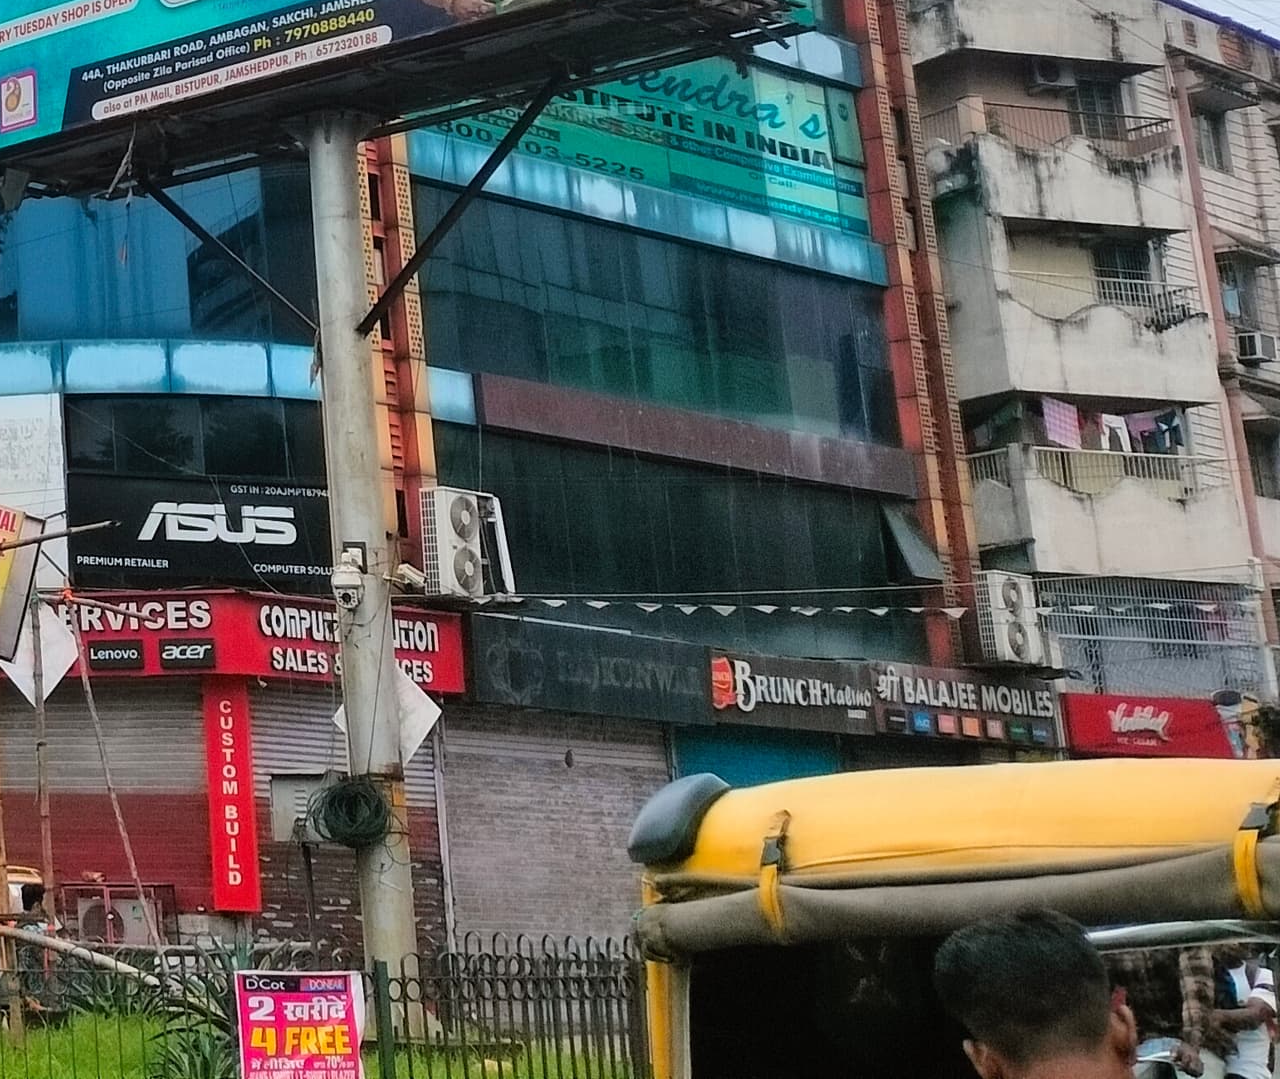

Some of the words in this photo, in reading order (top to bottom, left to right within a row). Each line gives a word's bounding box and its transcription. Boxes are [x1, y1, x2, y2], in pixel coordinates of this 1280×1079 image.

[13, 14, 61, 38] TUESDAY
[61, 4, 90, 24] SHOP
[91, 1, 102, 15] IS
[81, 66, 105, 84] 44A,
[105, 48, 173, 77] THAKURBARI
[173, 38, 208, 60] ROAD,
[208, 21, 271, 48] AMBAGAN,
[271, 7, 319, 31] SAKCHI,
[102, 70, 151, 94] (Opposite
[152, 61, 174, 80] Zila
[215, 42, 252, 65] Office)
[253, 35, 273, 53] Ph
[283, 8, 376, 43] 7970888440
[103, 100, 122, 114] also
[134, 90, 150, 107] PM
[174, 72, 224, 97] BISTUPUR,
[224, 54, 293, 82] JAMSHEDPUR,
[294, 49, 309, 63] Ph
[315, 32, 380, 58] 6572320188
[703, 120, 737, 145] IN
[744, 129, 834, 170] INDIA
[230, 484, 248, 495] GST
[137, 502, 298, 545] ASUS
[76, 555, 123, 567] PREMIUM
[124, 558, 169, 569] RETAILER
[253, 562, 306, 575] COMPUTER
[90, 647, 138, 660] Lenovo
[161, 644, 213, 660] acer
[272, 646, 329, 675] SALES
[904, 673, 978, 711] BALAJEE
[981, 684, 1054, 719] MOBILES
[219, 700, 238, 795] CUSTOM
[224, 804, 242, 886] BUILD
[245, 976, 286, 990] D'Cot
[248, 996, 276, 1021] 2
[282, 995, 348, 1021] खरीदें
[250, 1027, 277, 1057] 4
[285, 1025, 352, 1055] FREE
